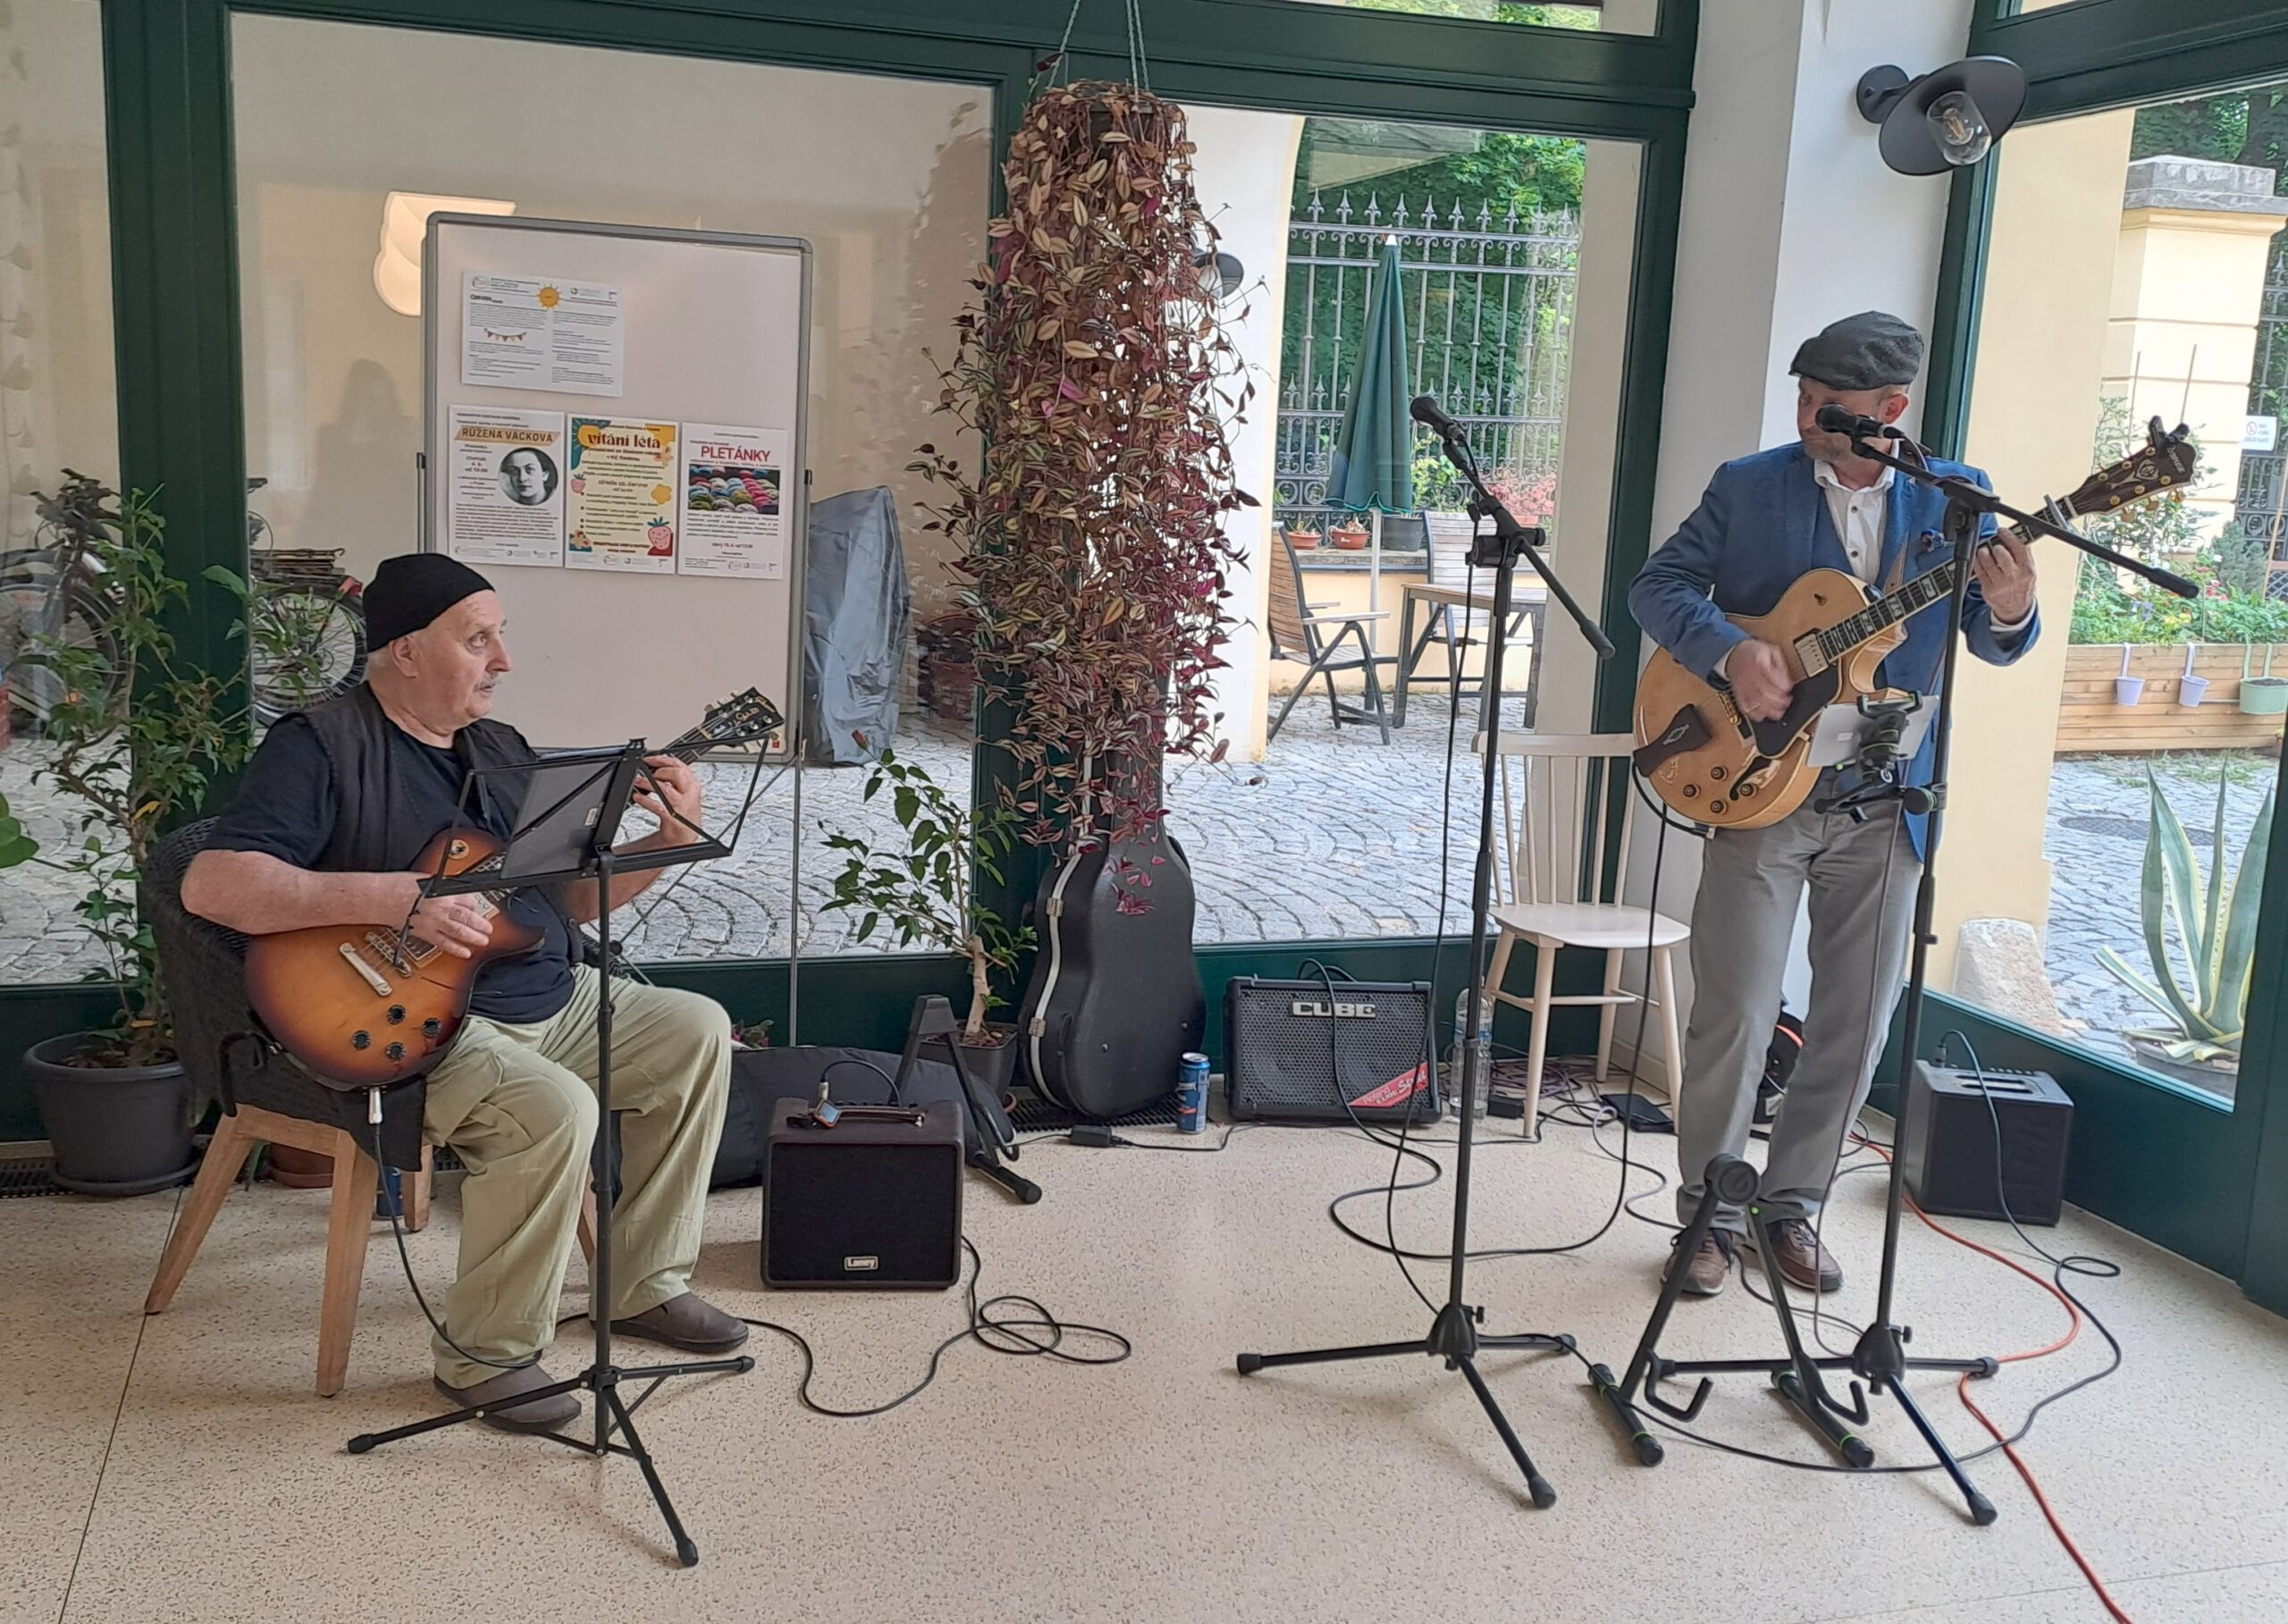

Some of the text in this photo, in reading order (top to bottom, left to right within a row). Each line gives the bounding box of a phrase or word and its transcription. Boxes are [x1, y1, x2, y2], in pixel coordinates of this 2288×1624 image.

[634, 434, 660, 449] léta
[701, 445, 771, 462] PLETÁNKY
[1292, 1001, 1376, 1018] CUBE
